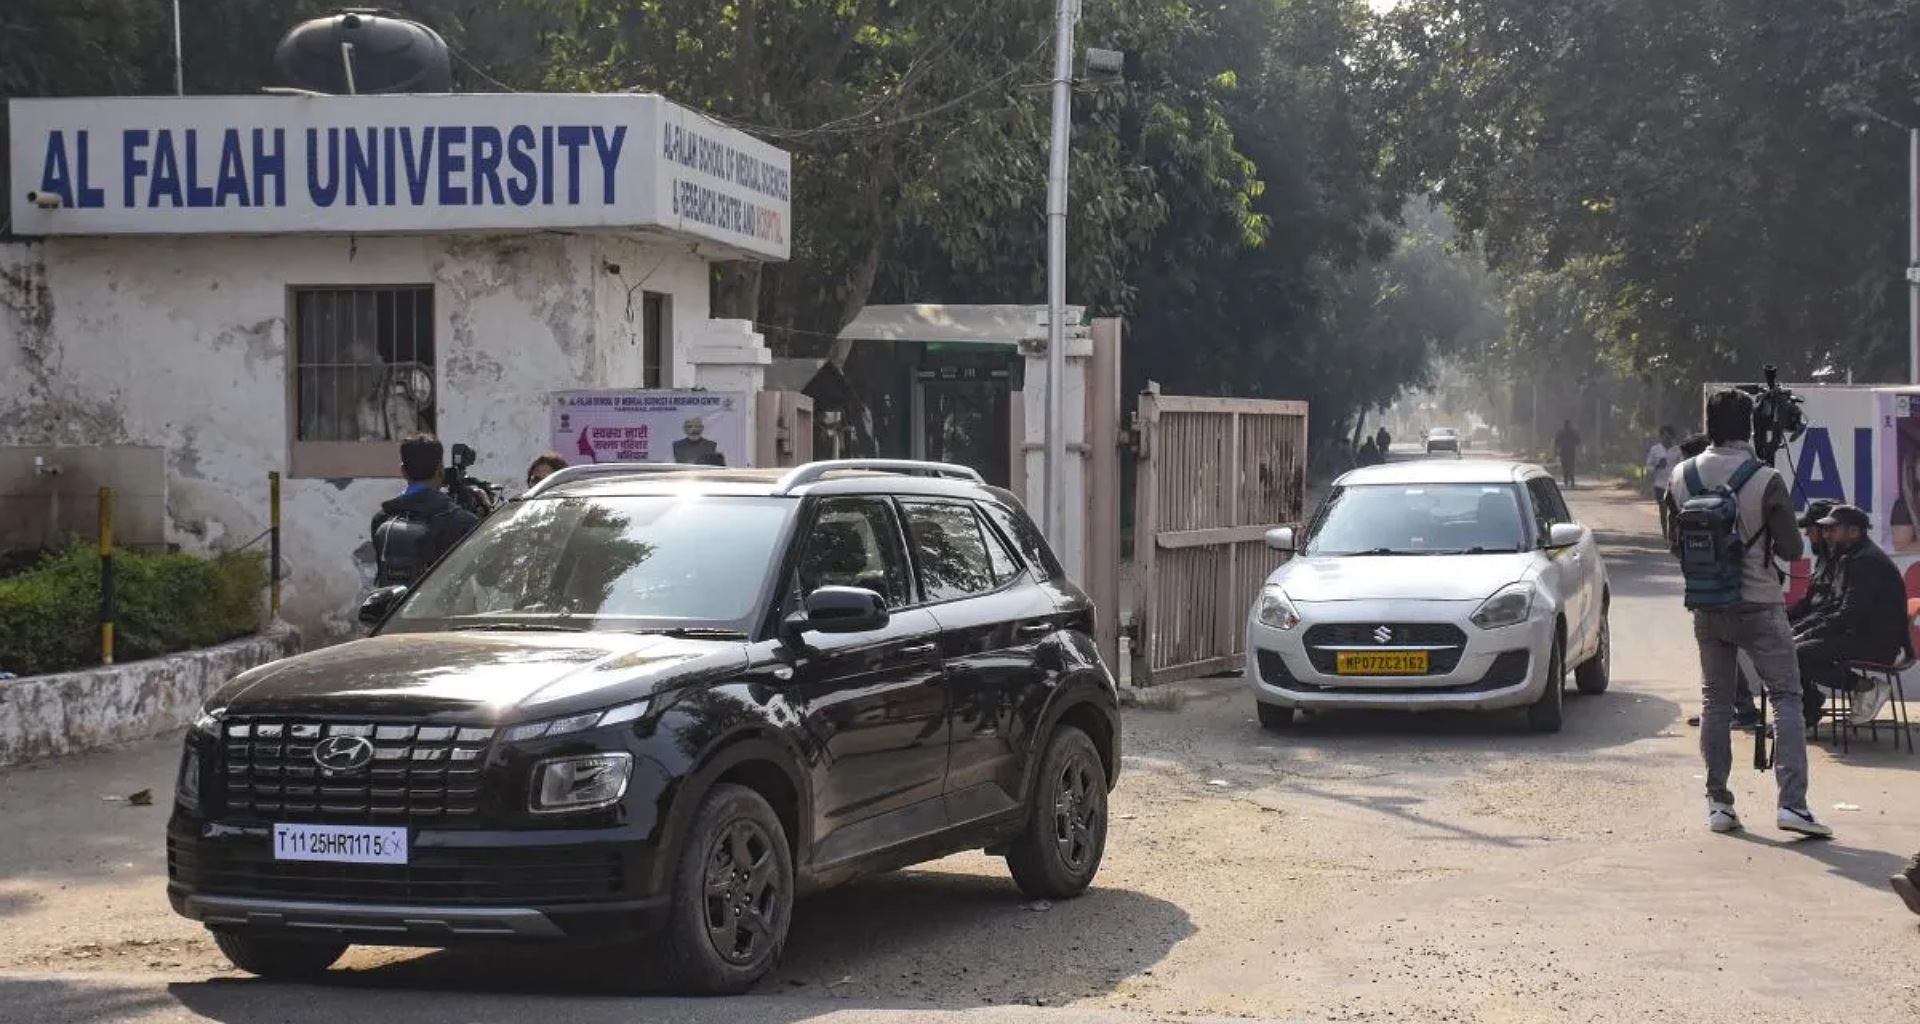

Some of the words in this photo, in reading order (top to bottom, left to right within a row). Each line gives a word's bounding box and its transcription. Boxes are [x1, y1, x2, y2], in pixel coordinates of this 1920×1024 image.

[41, 129, 104, 208] AL
[123, 128, 285, 208] FALAH
[306, 124, 628, 207] UNIVERSITY
[699, 135, 725, 180] SCHOOL
[726, 146, 735, 182] OF
[735, 150, 761, 192] MEDICAL
[761, 161, 788, 203] SCIENCES
[681, 180, 716, 226] RESEARCH
[717, 192, 742, 233] CENTRE
[743, 202, 756, 237] AND
[592, 427, 621, 438] स्वस्थ
[624, 424, 648, 438] नारी
